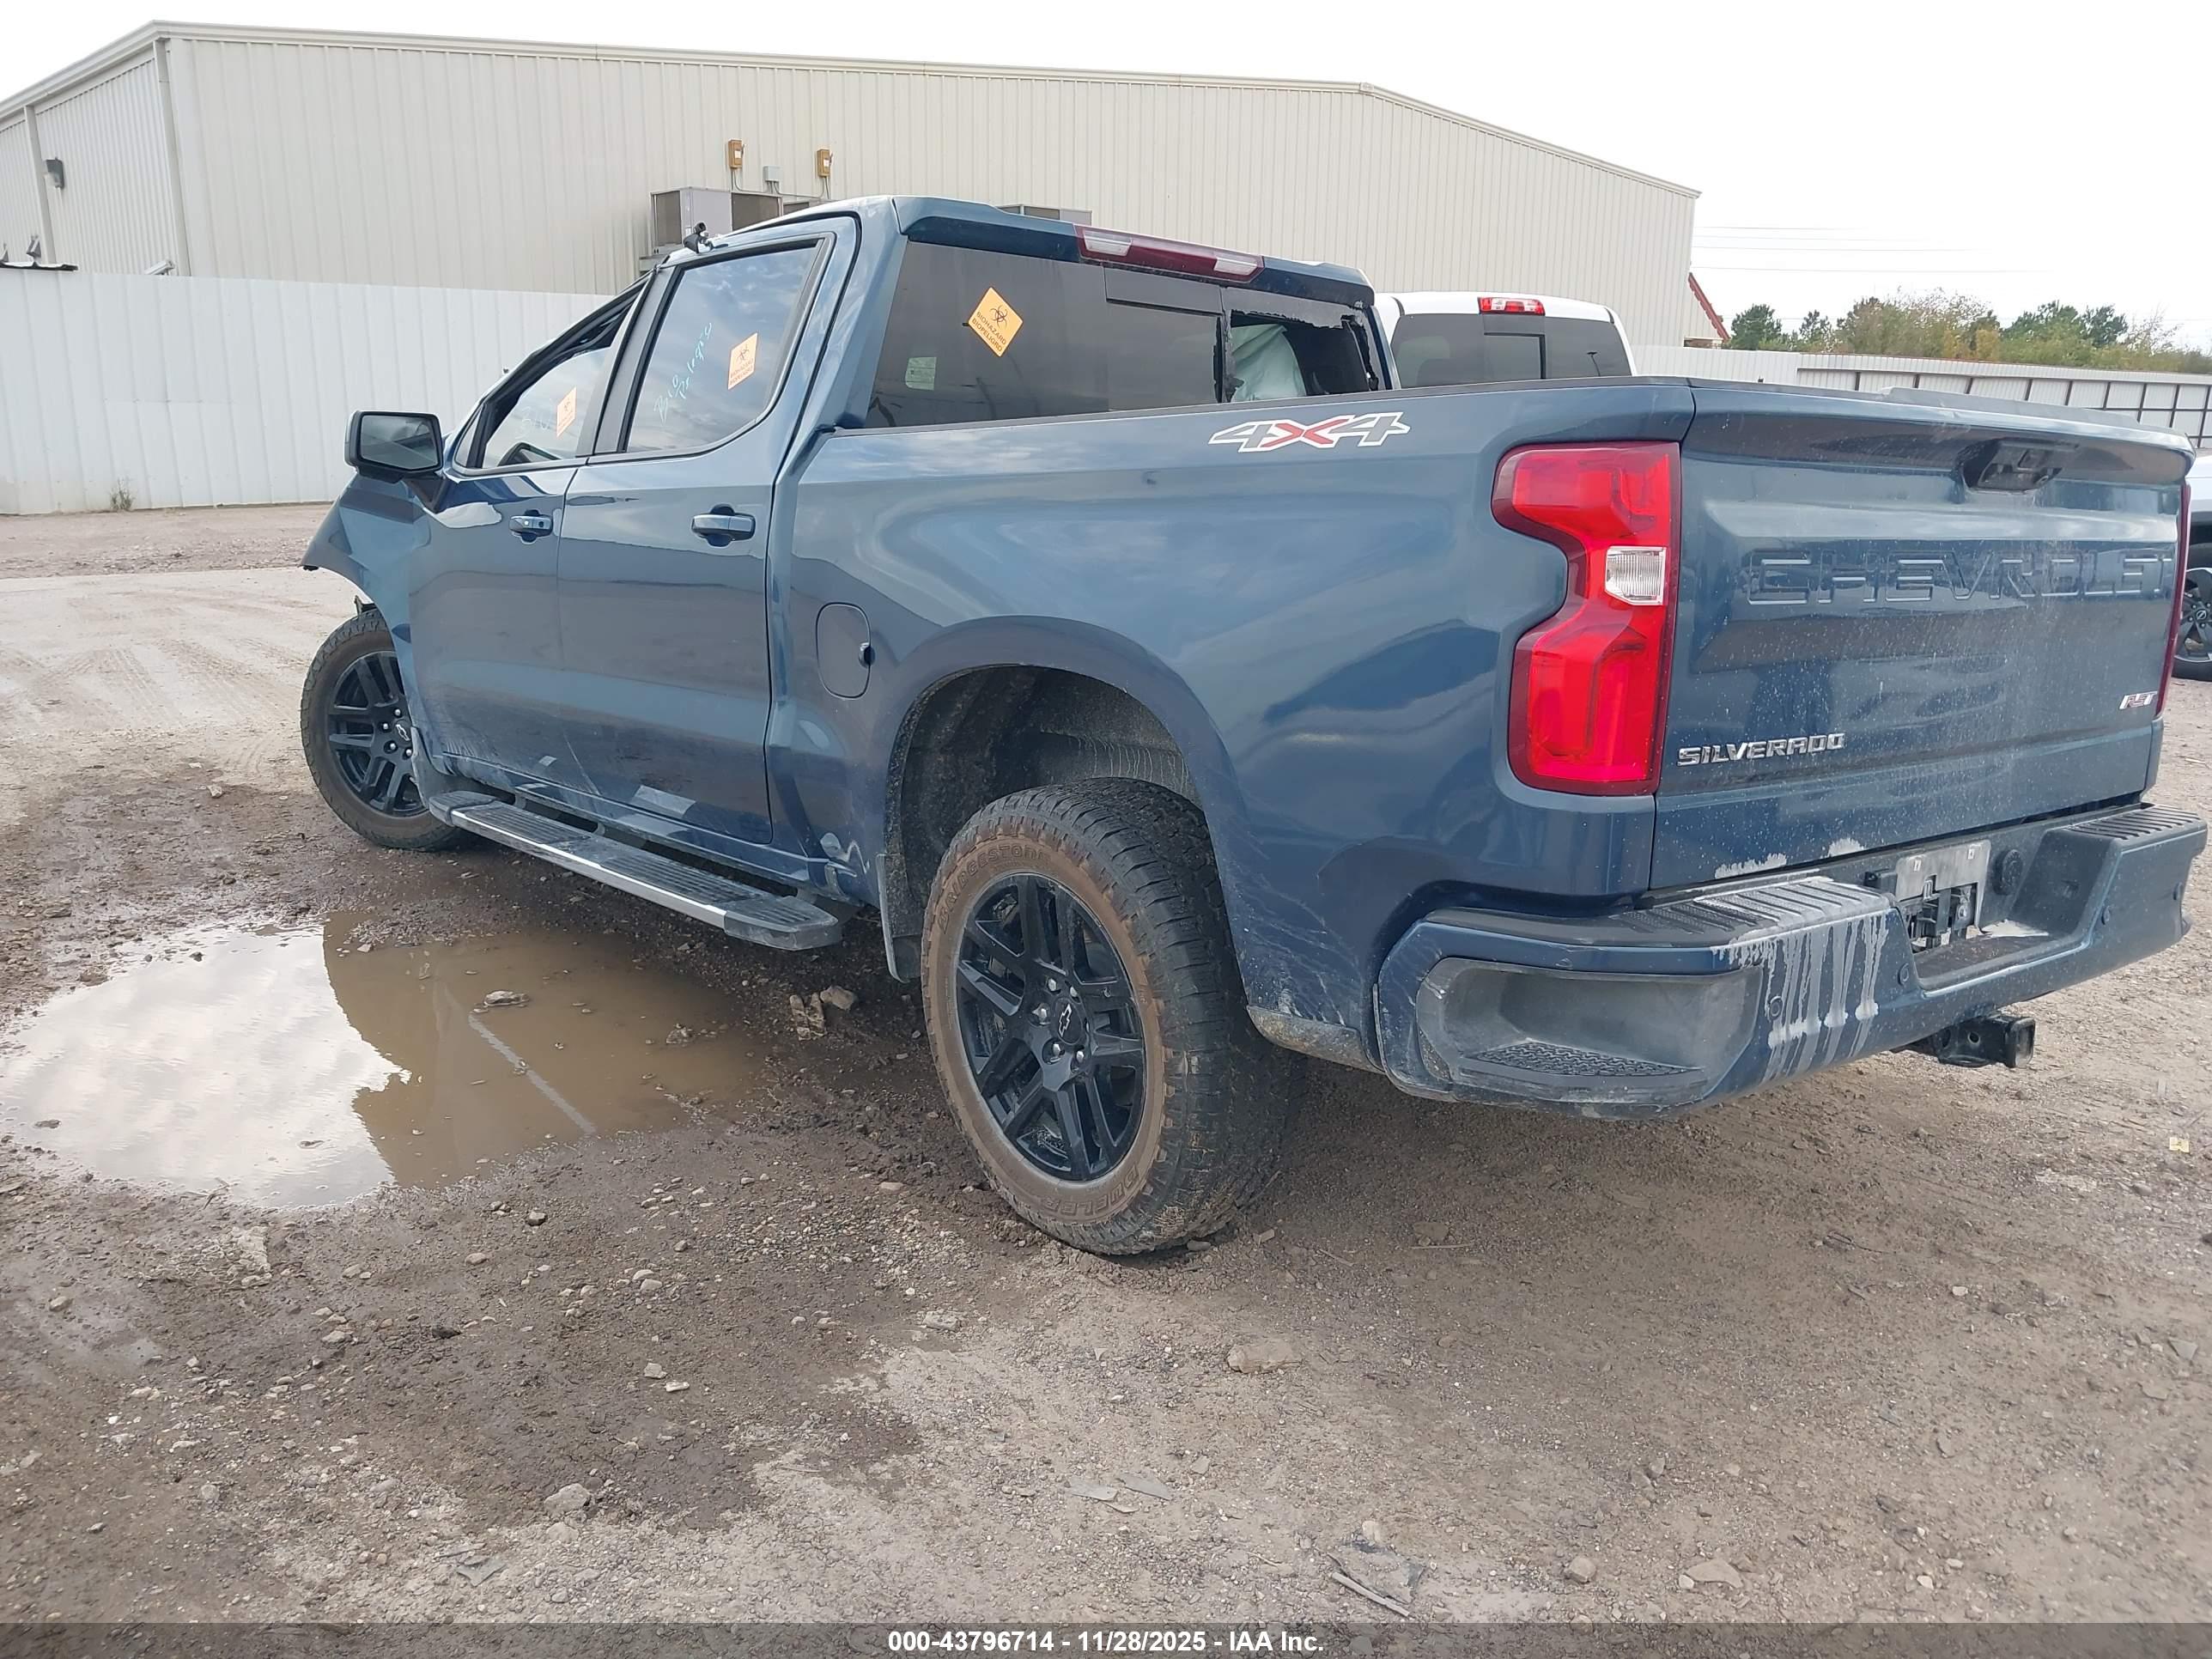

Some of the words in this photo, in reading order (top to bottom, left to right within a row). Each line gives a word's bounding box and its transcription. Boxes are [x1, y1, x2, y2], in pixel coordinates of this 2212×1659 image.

[970, 317, 1003, 352] BIOPELIGRO
[976, 310, 1007, 345] BIOHAZARD
[1747, 550, 2173, 605] CHEVROLET
[2119, 690, 2158, 710] RST
[1677, 732, 1845, 767] SILVERADO
[1042, 1164, 1140, 1217] DUELER
